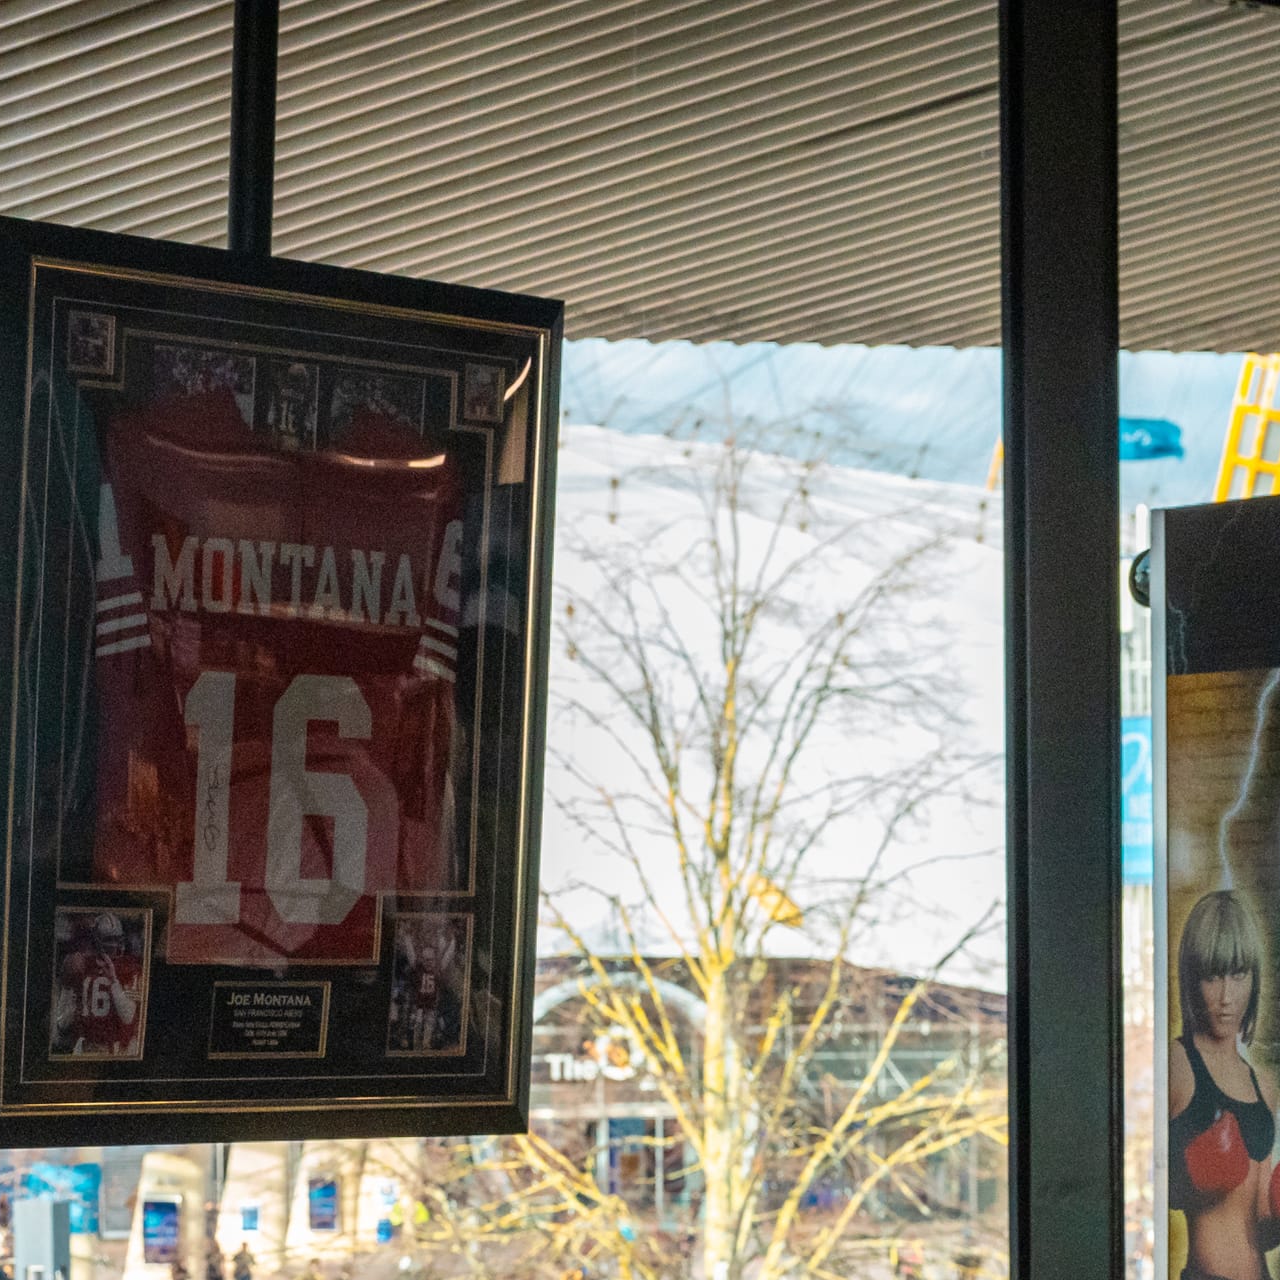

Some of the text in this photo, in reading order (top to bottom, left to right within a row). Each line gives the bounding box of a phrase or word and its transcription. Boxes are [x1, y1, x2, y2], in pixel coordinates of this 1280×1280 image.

[150, 533, 420, 627] MONTANA
[175, 671, 372, 925] 16
[82, 976, 111, 1017] 16
[227, 992, 312, 1006] JOE MONTANA
[545, 1053, 599, 1082] The
